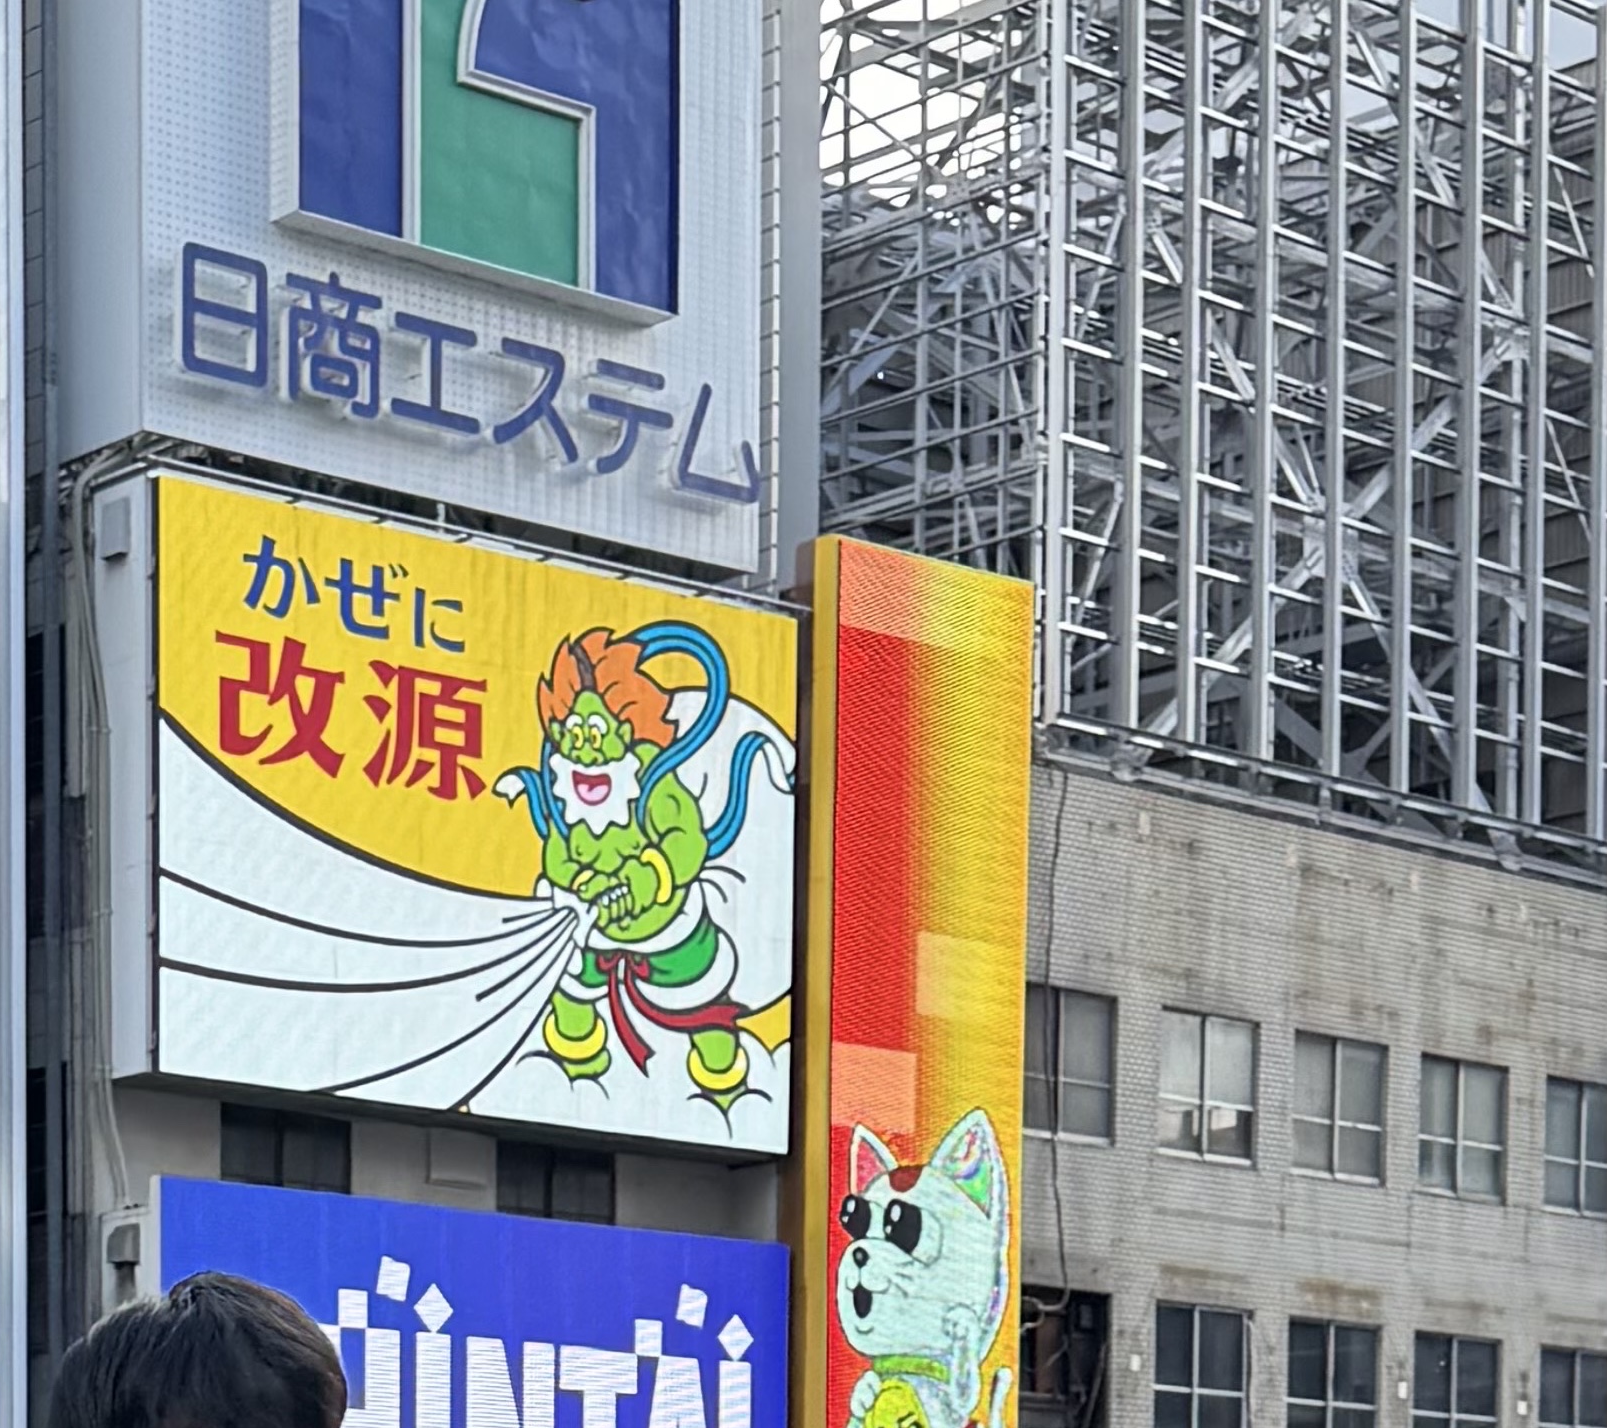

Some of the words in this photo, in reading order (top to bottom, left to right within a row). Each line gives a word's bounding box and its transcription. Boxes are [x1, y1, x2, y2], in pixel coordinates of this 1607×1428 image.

[182, 241, 761, 504] 日商エステム
[242, 534, 467, 654] かぜに
[214, 630, 488, 801] 改源
